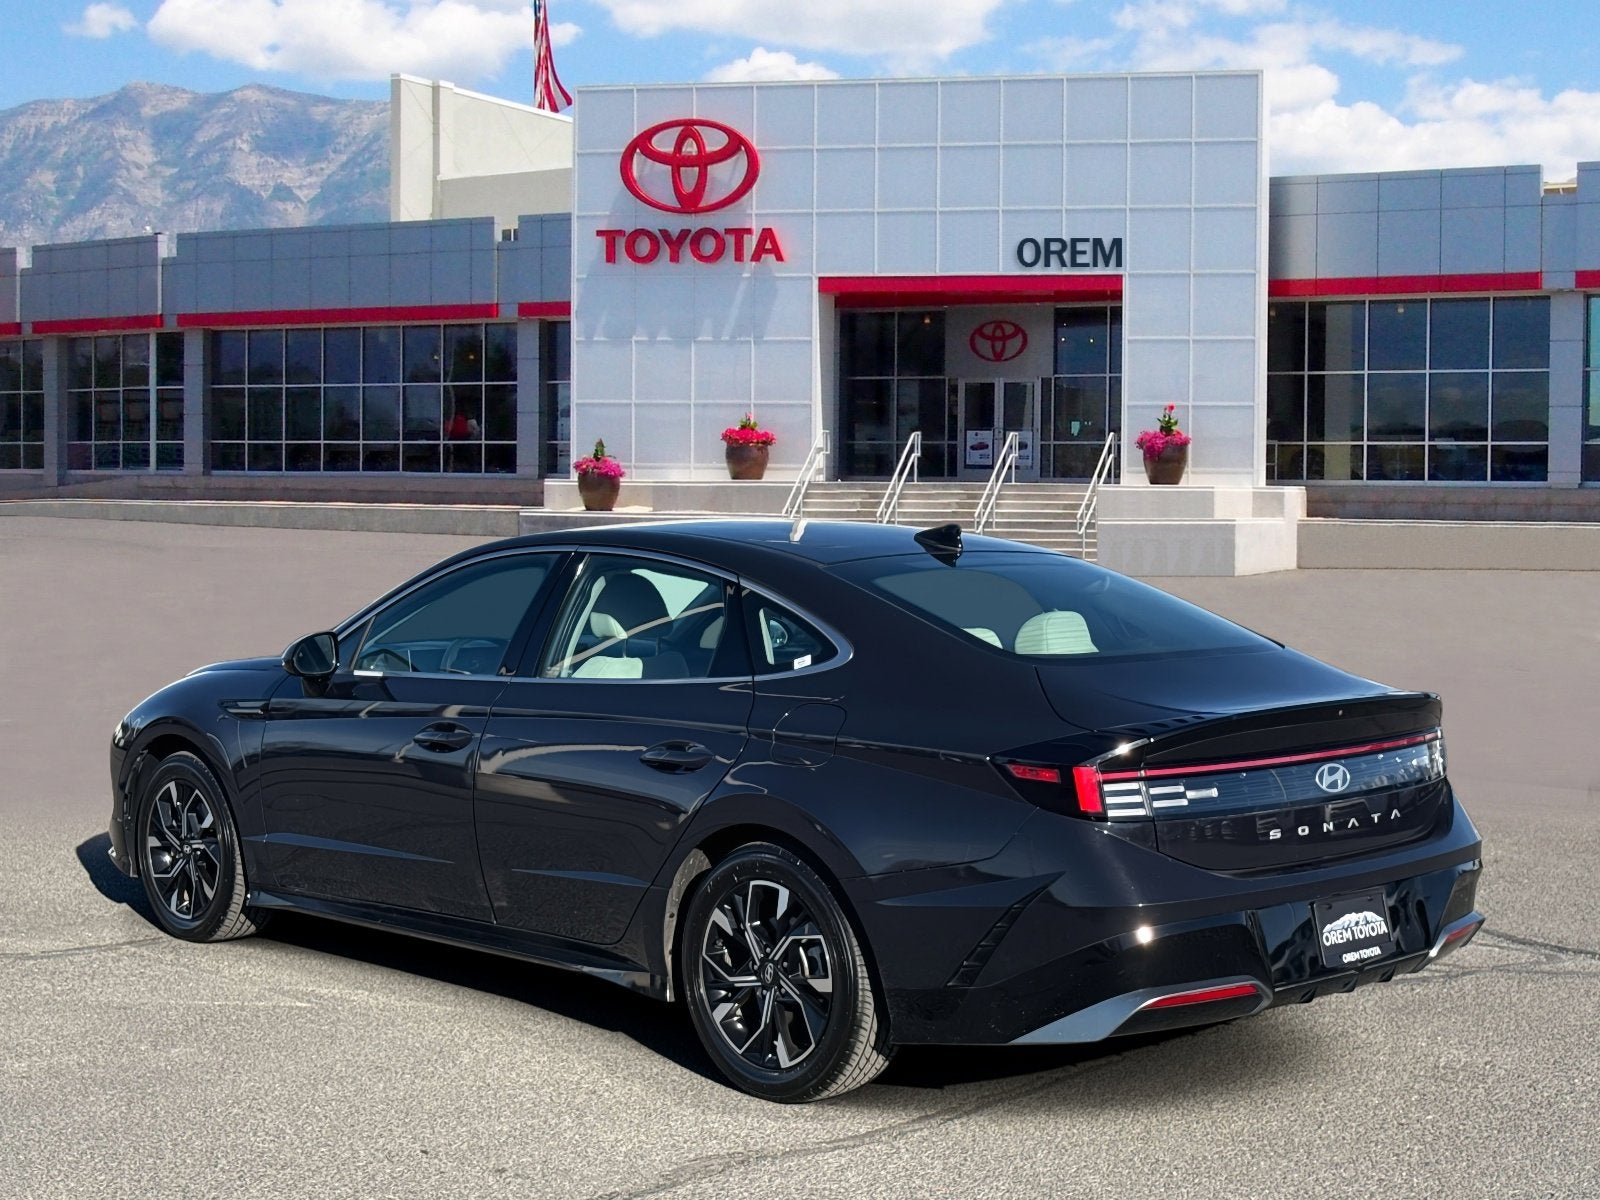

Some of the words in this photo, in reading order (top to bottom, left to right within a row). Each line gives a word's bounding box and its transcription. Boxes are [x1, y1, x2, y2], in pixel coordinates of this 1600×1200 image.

[596, 227, 784, 264] TOYOTA
[1017, 238, 1123, 268] OREM
[1269, 808, 1401, 840] SONATA
[1323, 928, 1353, 946] OREM
[1352, 921, 1388, 940] TOYOTA
[1342, 952, 1360, 963] OREM
[1360, 946, 1381, 959] TOYOTA
